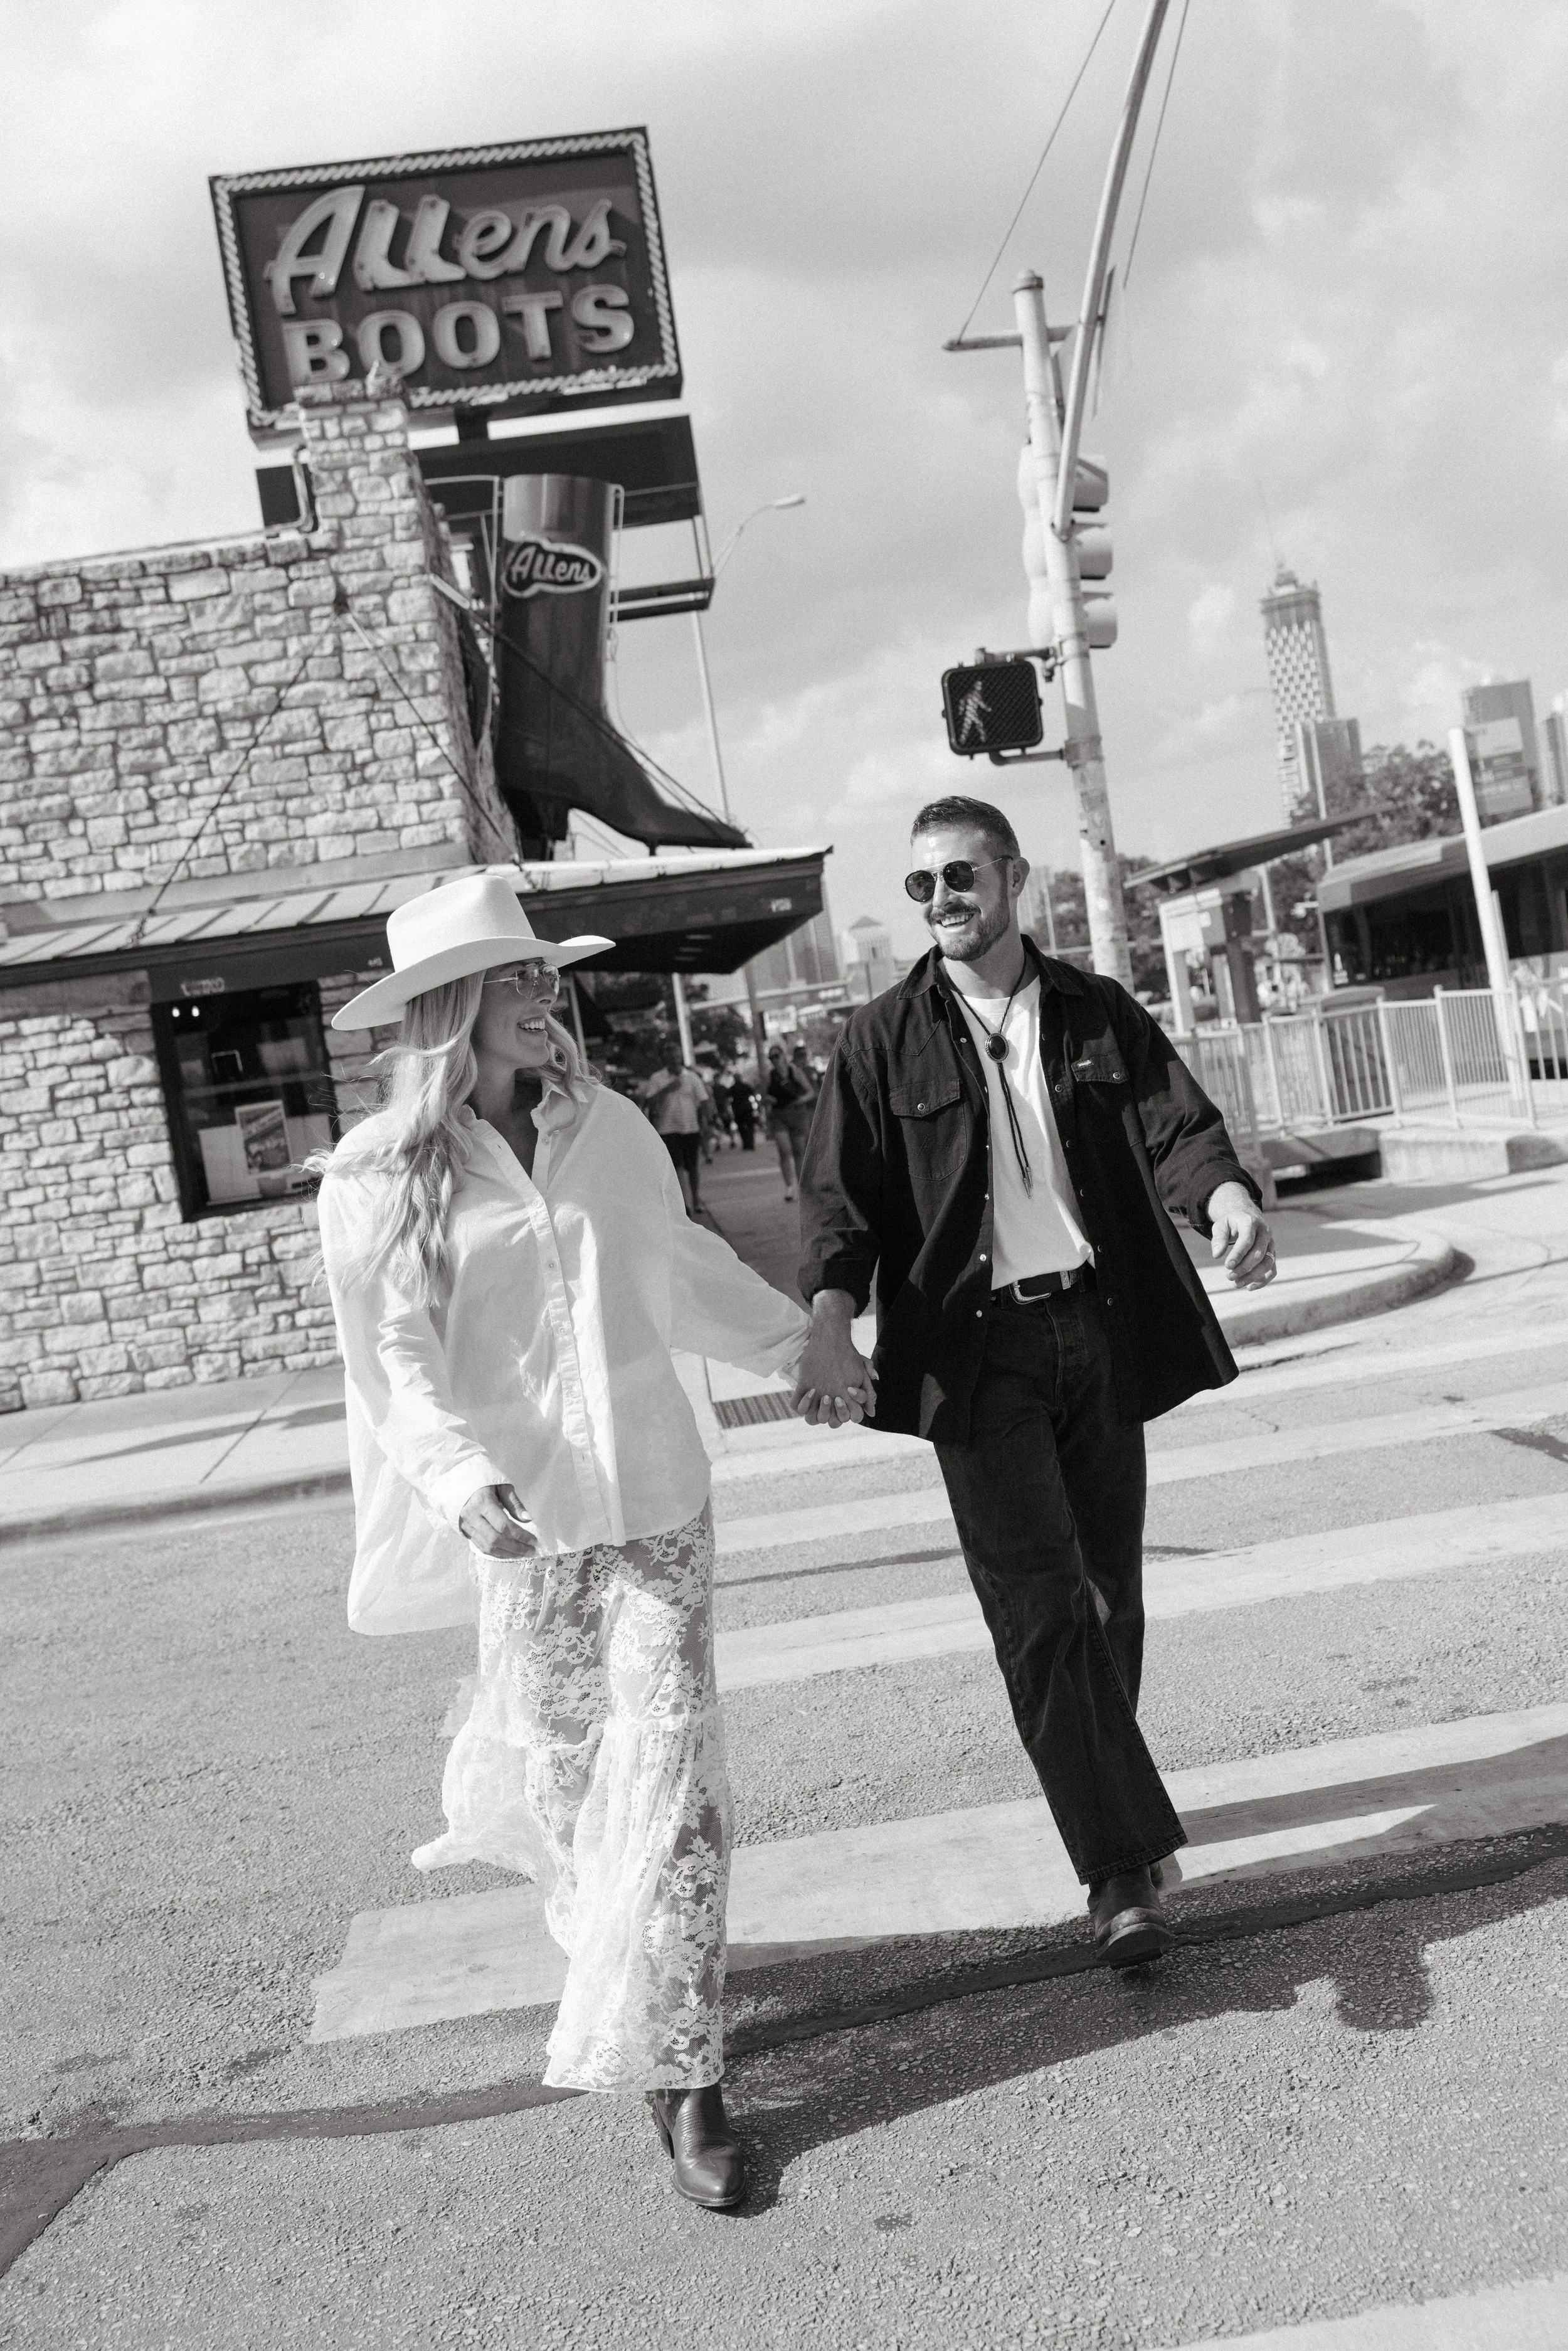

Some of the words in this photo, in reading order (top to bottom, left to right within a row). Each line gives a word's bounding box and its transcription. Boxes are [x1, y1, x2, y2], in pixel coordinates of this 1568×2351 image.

[263, 184, 626, 315] Allens
[282, 284, 634, 383] BOOTS
[511, 545, 591, 584] Allens
